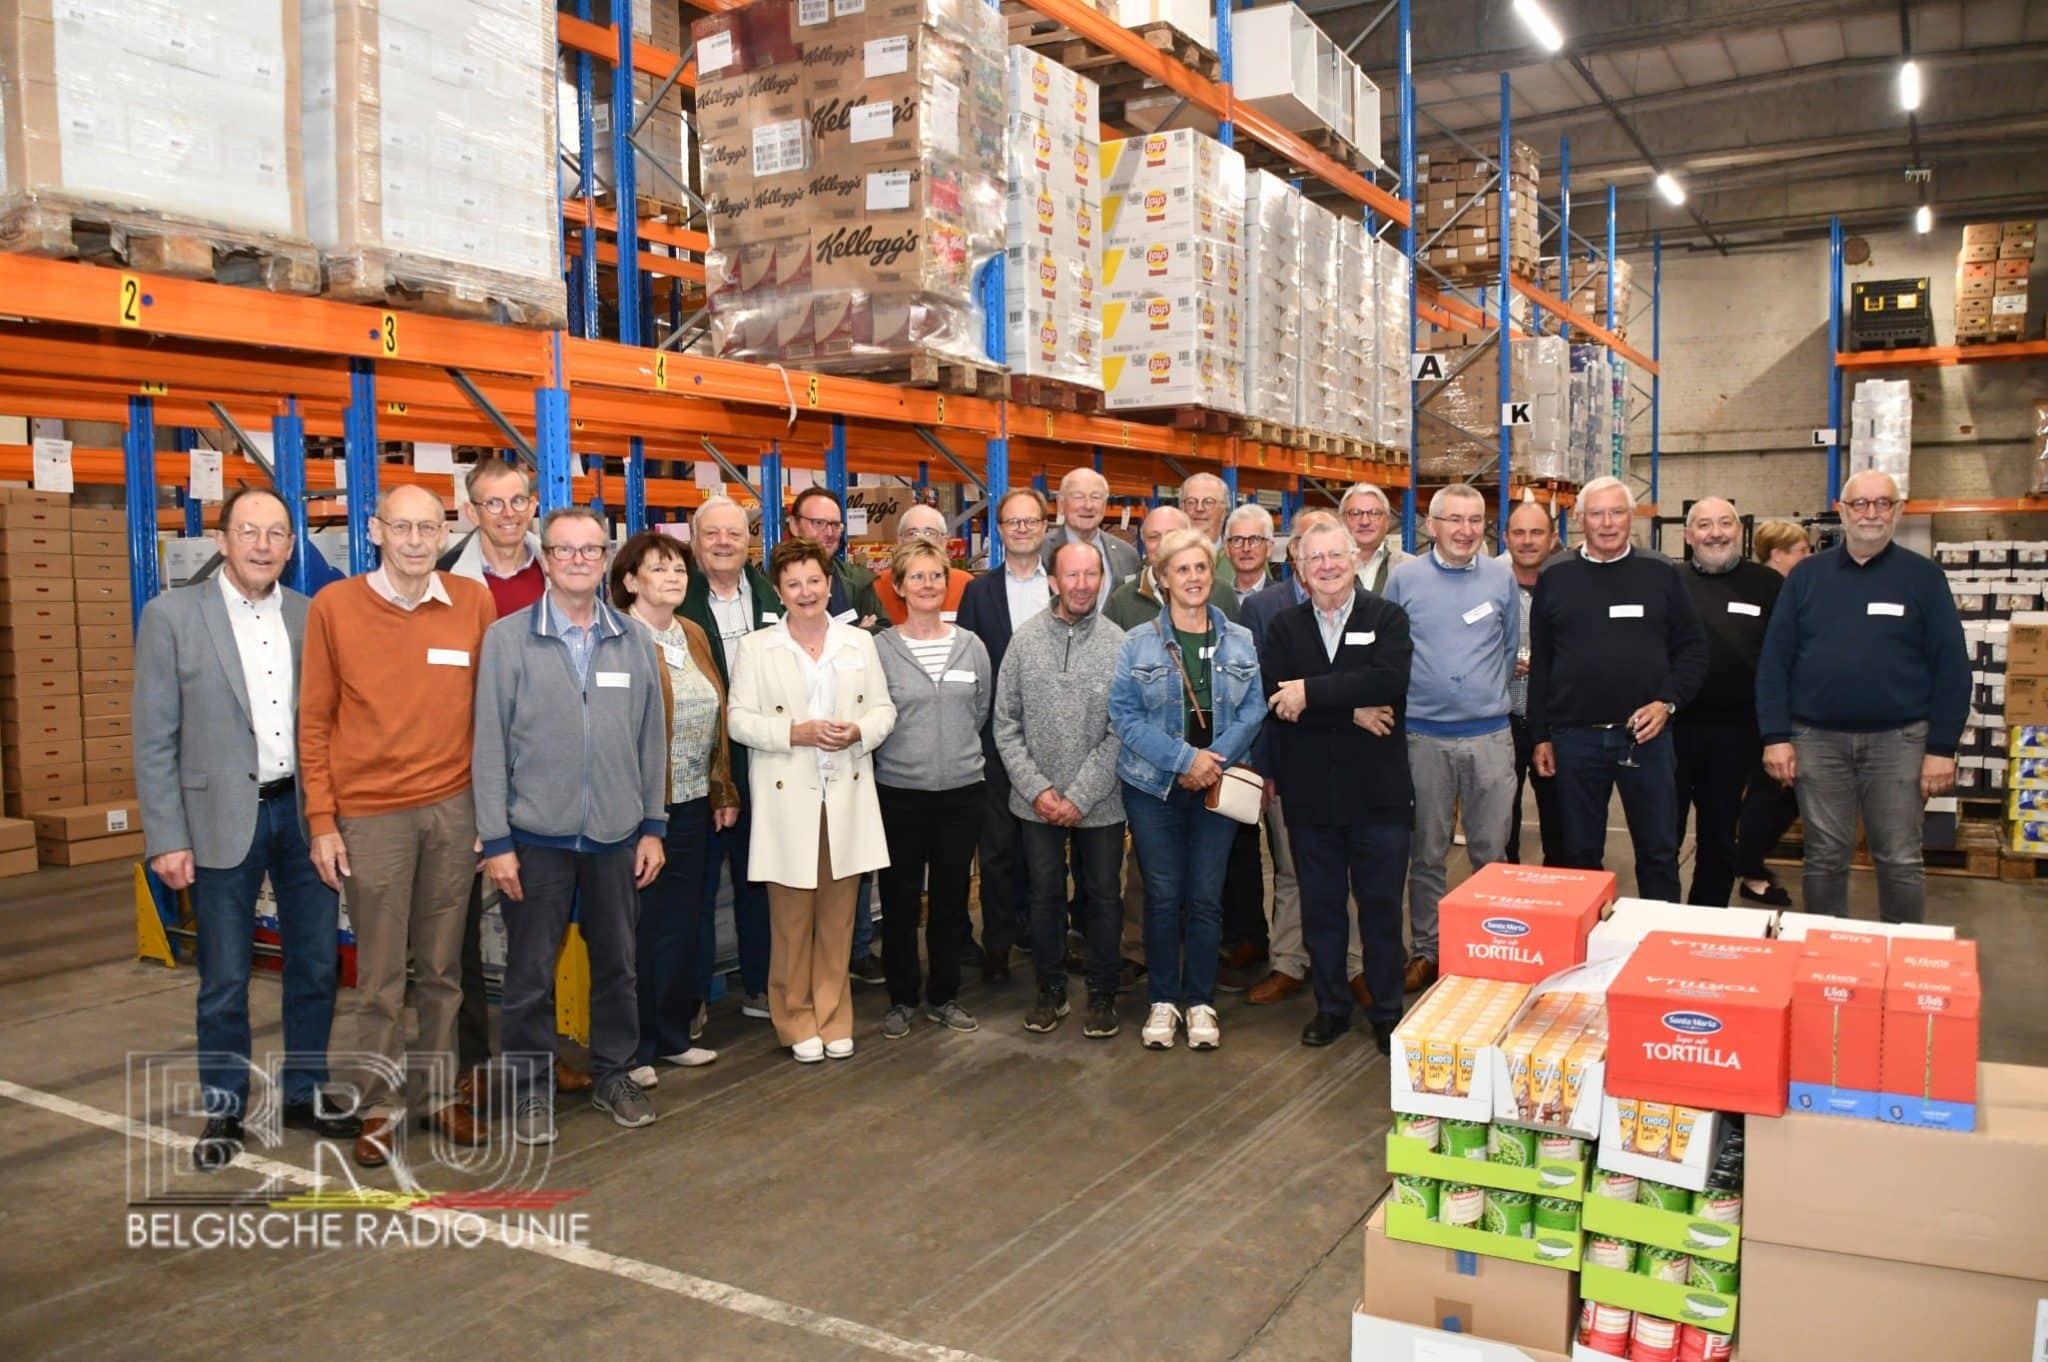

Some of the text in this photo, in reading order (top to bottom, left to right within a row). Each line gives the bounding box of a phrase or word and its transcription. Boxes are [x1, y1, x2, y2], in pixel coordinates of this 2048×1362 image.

[697, 85, 743, 109] Kellogg's
[749, 73, 799, 97] Kellogg's
[808, 172, 862, 195] Kellogg's
[754, 187, 804, 208] Kellogg's
[816, 225, 919, 266] Kellogg's
[124, 280, 137, 321] 2
[385, 316, 395, 352] 3
[656, 355, 665, 385] 4
[1417, 355, 1442, 379] A
[809, 378, 817, 405] 5
[1511, 404, 1530, 423] K
[1814, 431, 1825, 444] L
[1466, 943, 1544, 966] TORTILLA
[1669, 1015, 1717, 1028] Santa Maria
[1642, 1042, 1741, 1071] TORTILLA
